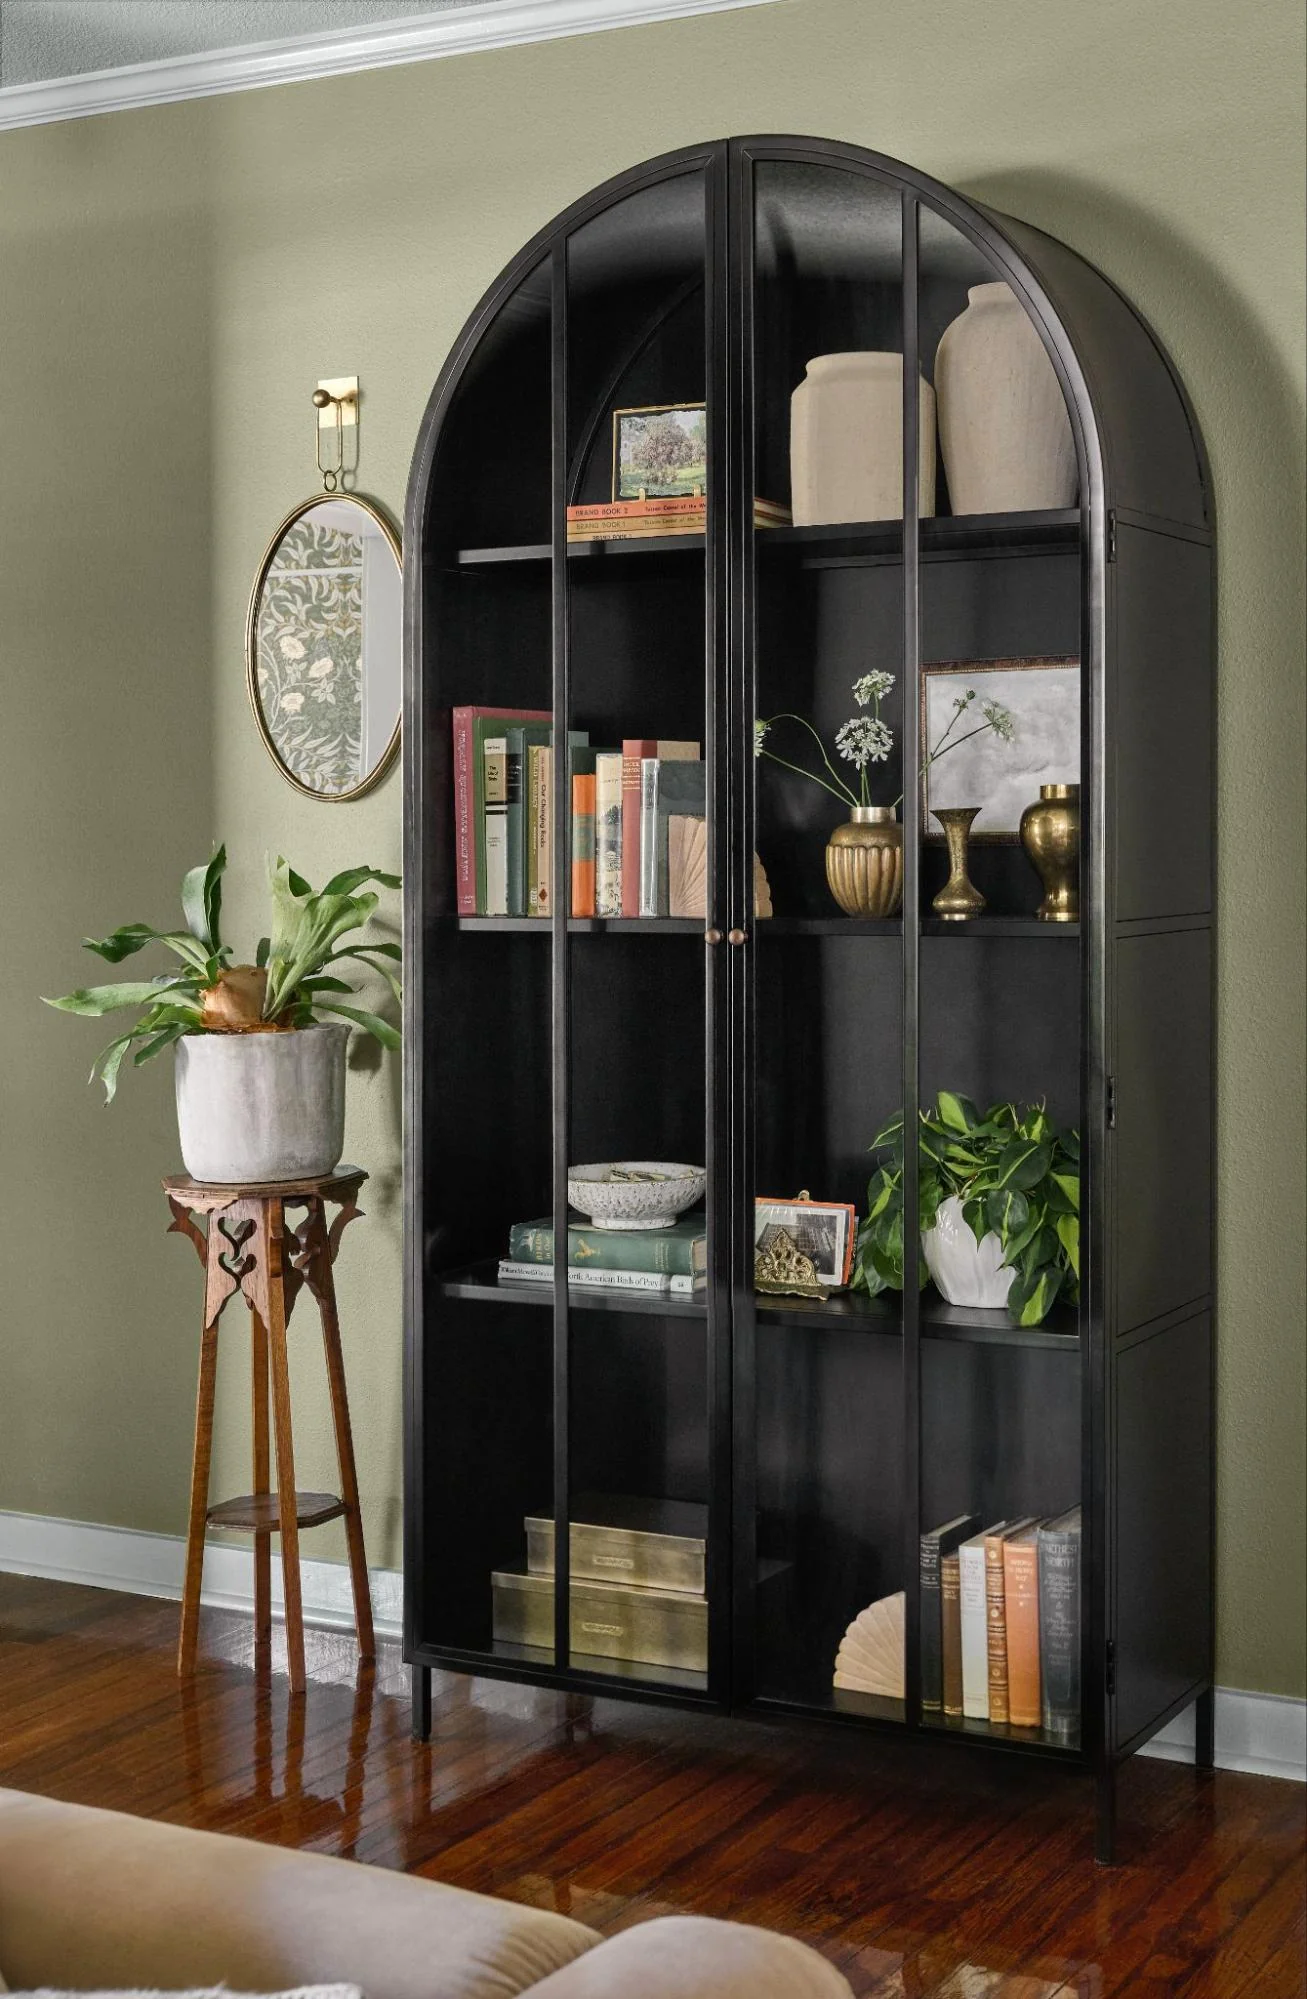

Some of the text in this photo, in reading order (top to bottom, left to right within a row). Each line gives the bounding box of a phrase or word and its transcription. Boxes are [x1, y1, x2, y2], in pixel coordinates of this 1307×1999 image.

[575, 509, 598, 517] BRAND
[601, 508, 621, 516] BOOK
[576, 522, 599, 530] BRAND
[601, 521, 621, 529] BOOK
[568, 1271, 659, 1288] orth American Birds of Prey
